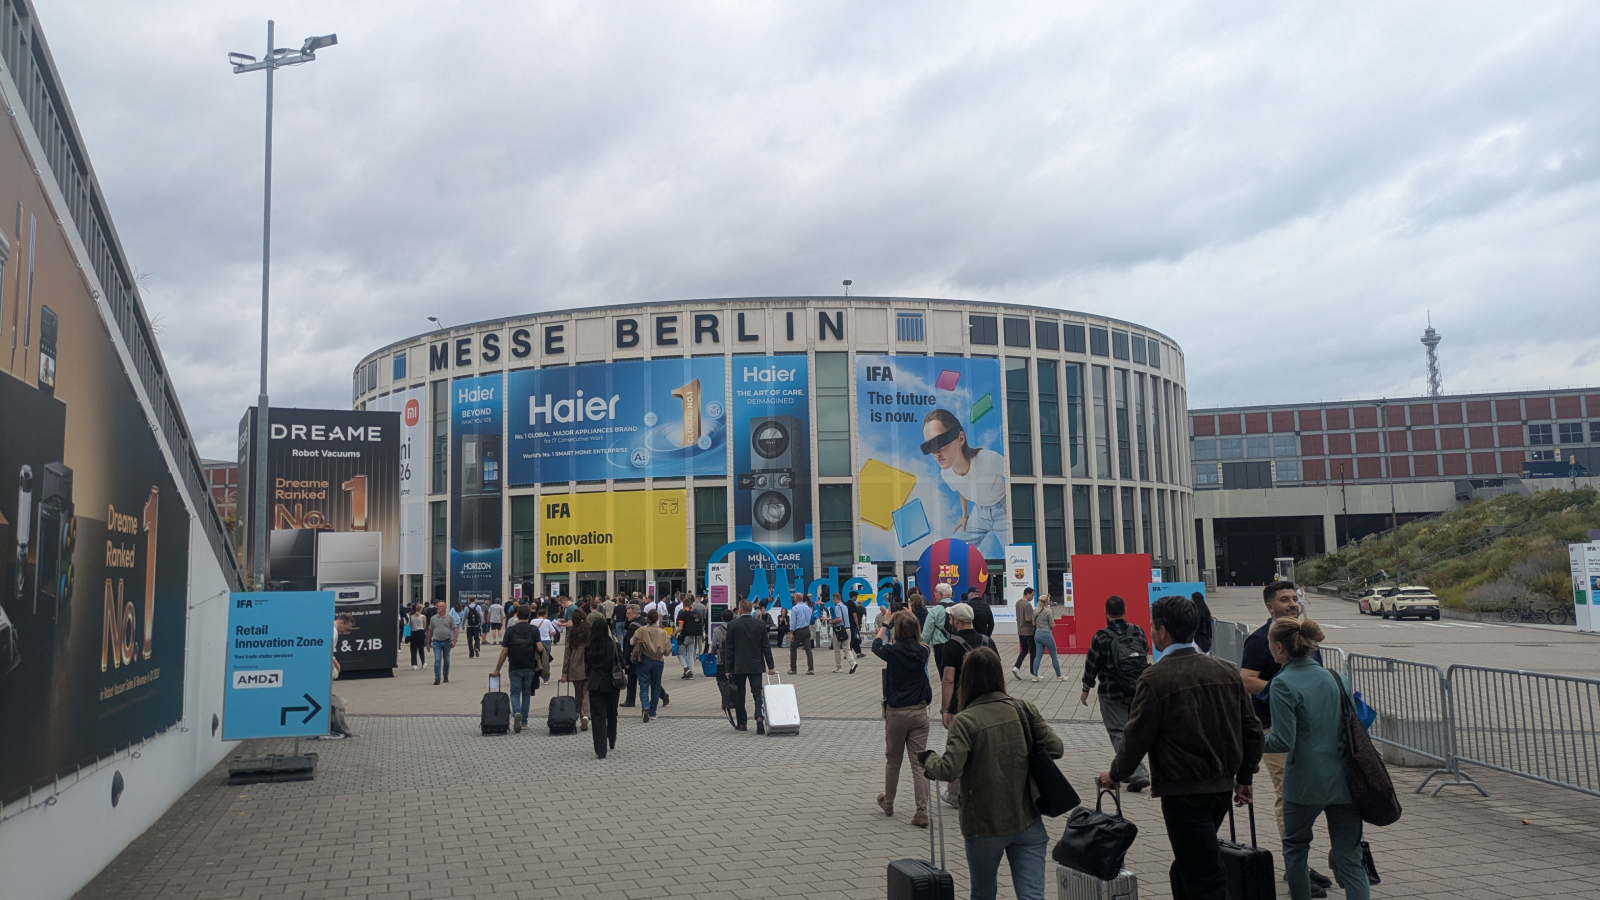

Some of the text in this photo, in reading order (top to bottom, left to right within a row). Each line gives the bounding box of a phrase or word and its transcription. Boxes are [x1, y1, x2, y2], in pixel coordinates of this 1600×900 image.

[430, 311, 844, 372] MESSE BERLIN
[743, 365, 797, 382] Haier
[866, 366, 894, 381] IFA
[458, 386, 495, 404] Haier
[867, 392, 936, 405] The future
[462, 408, 492, 418] BEYOND
[529, 390, 620, 426] Haier
[870, 409, 918, 423] is now.
[271, 424, 382, 442] DREAME
[292, 449, 360, 458] Robot Vacuums
[275, 478, 329, 488] Dreame
[275, 490, 326, 500] Ranked
[342, 474, 368, 532] 1
[546, 502, 571, 519] IFA
[108, 503, 138, 536] Dreame
[546, 531, 613, 546] Innovation
[106, 540, 135, 568] Ranked
[546, 549, 584, 564] for all.
[1010, 556, 1028, 564] Midea
[464, 562, 492, 570] HORIZON
[102, 578, 139, 673] No.
[143, 485, 159, 660] 1
[237, 600, 253, 608] IFA
[236, 625, 268, 636] Retail
[235, 637, 324, 648] Innovation Zone
[341, 638, 382, 652] & 7.1B
[238, 675, 268, 684] AMD
